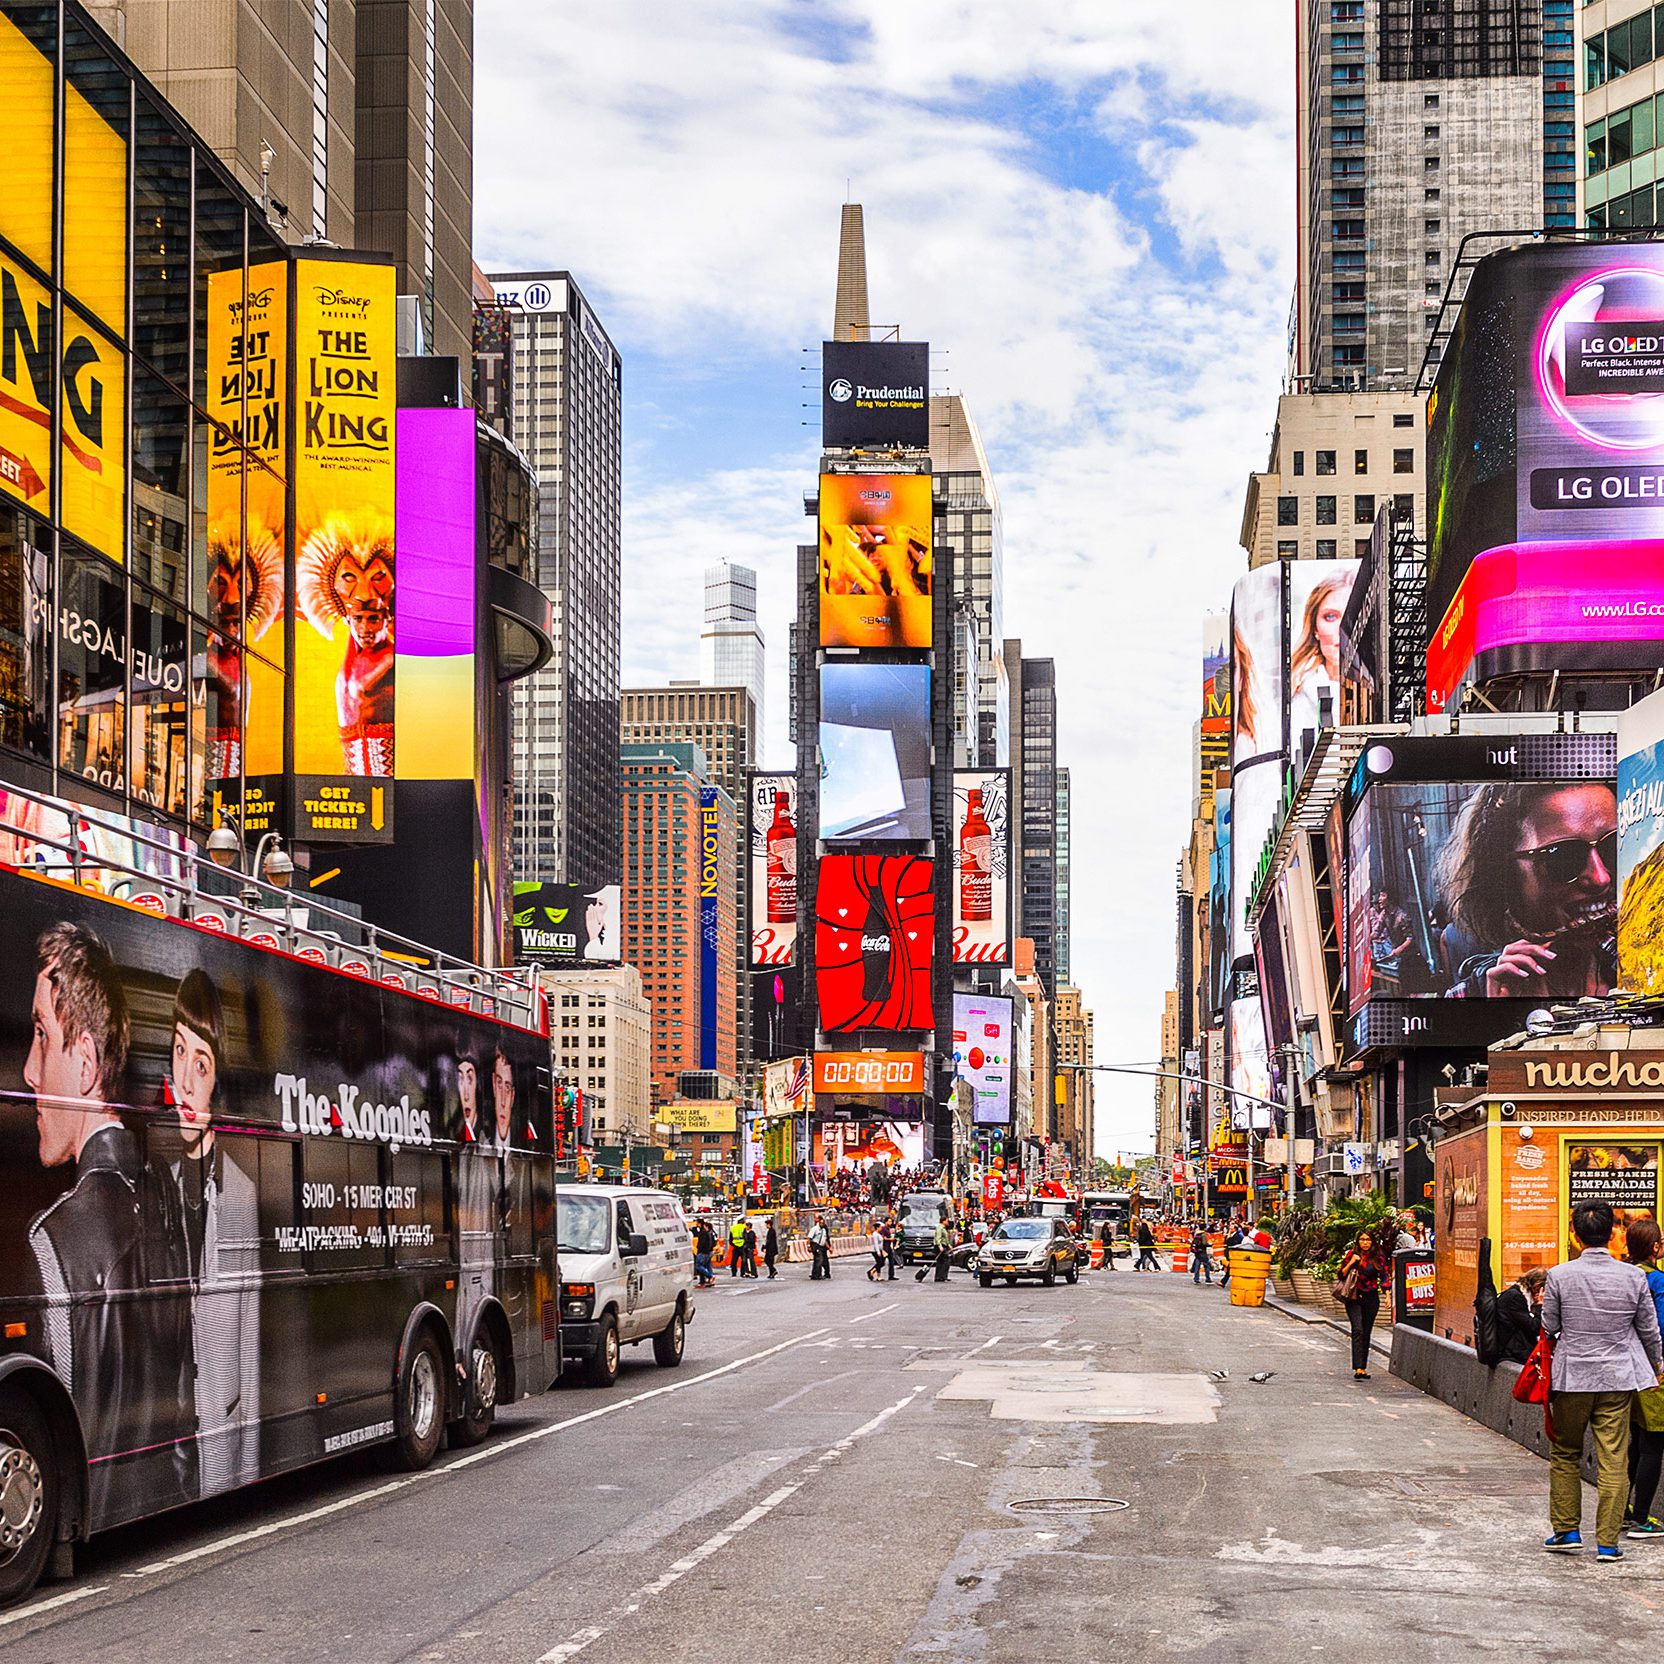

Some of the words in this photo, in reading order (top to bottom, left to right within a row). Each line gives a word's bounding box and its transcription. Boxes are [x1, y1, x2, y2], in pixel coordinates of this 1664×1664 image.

[312, 286, 371, 312] Disney
[322, 311, 368, 320] PRESENTS
[318, 330, 368, 354] THE
[1581, 338, 1604, 355] LG
[1608, 336, 1659, 354] OLED
[1581, 359, 1609, 368] Perfect
[1633, 358, 1661, 367] Intense
[310, 358, 378, 398] LION
[1599, 368, 1644, 378] INCREDIBLE
[856, 385, 924, 400] Prudential
[856, 400, 874, 409] Bring
[875, 400, 889, 408] Your
[889, 400, 924, 410] Challenges
[305, 401, 389, 449] KING
[1558, 477, 1593, 500] LG
[320, 787, 350, 800] GET
[304, 800, 366, 814] TICKETS
[312, 816, 358, 830] HERE!
[700, 798, 718, 898] NOVOTEL
[824, 1062, 914, 1083] 00:00:00
[275, 1072, 333, 1137] The
[338, 1083, 433, 1155] Kooples
[1515, 1110, 1576, 1122] INSPIRED
[1579, 1110, 1661, 1122] HAND-HELD
[1517, 1149, 1544, 1159] FRESH
[1517, 1155, 1544, 1165] BAKED
[988, 1178, 998, 1199] tkts
[1571, 1179, 1656, 1189] EMPANADAS
[303, 1183, 335, 1209] SOHO
[344, 1185, 358, 1209] 15
[1412, 1284, 1434, 1300] BOYS
